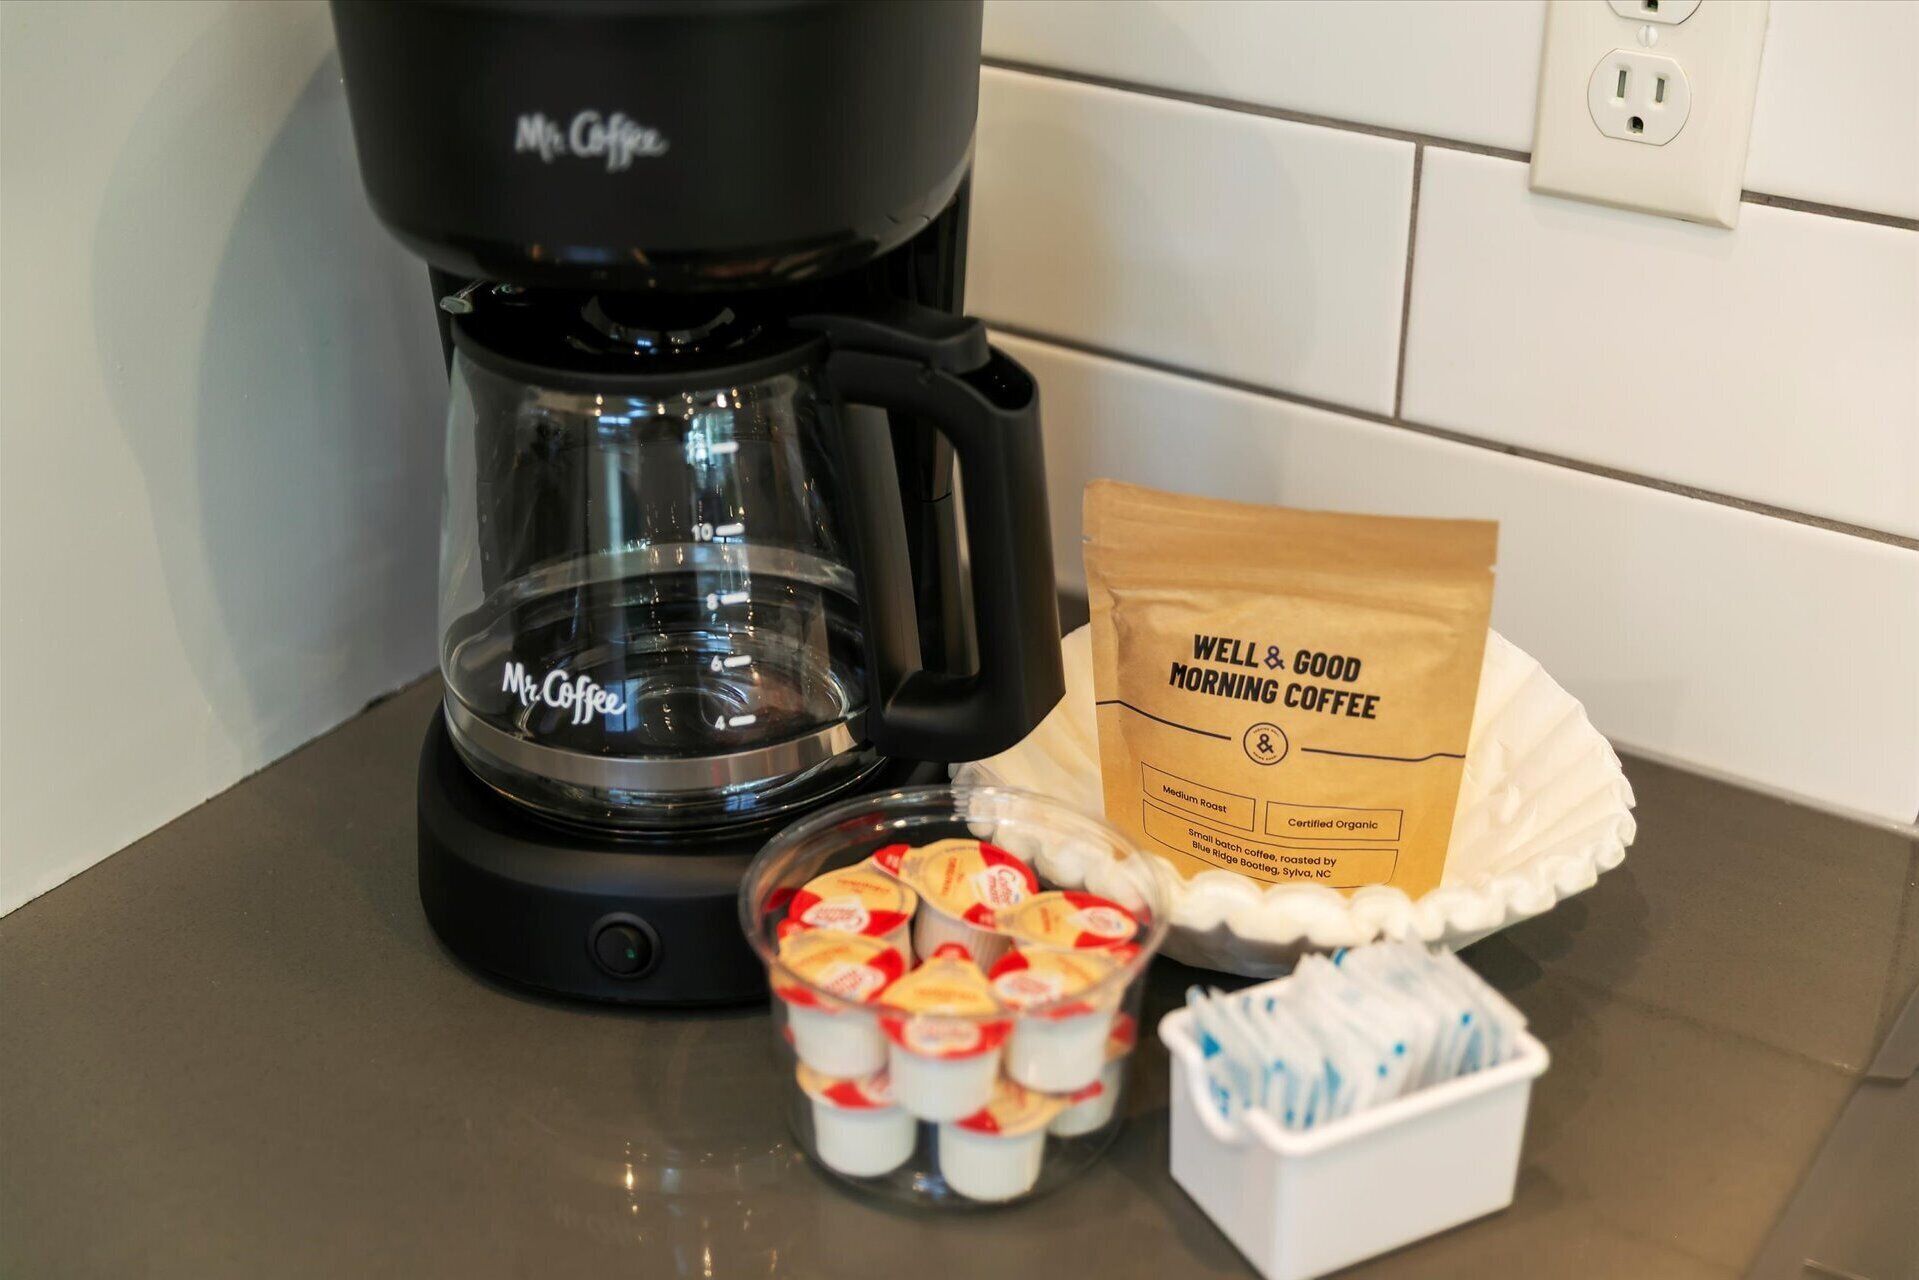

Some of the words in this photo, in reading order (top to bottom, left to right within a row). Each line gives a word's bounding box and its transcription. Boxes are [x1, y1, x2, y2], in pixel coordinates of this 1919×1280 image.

[569, 110, 670, 173] Coffee
[691, 523, 713, 541] 10
[707, 593, 719, 610] 8
[711, 656, 723, 672] 6
[1193, 634, 1259, 668] WELL
[1263, 645, 1285, 670] &
[1293, 649, 1361, 683] GOOD
[542, 669, 627, 725] Coffee
[1169, 662, 1279, 704] MORNING
[1284, 682, 1381, 719] COFFEE
[715, 714, 726, 731] 4
[1256, 733, 1274, 754] &
[1163, 785, 1198, 803] Medium
[1201, 798, 1227, 813] Roast
[1287, 817, 1333, 829] Certified
[1335, 819, 1378, 830] Organic
[1188, 827, 1214, 844] Small
[1215, 836, 1242, 853] batch
[1244, 846, 1278, 862] coffee,
[1280, 854, 1320, 866] roasted
[1323, 856, 1337, 867] by
[1192, 840, 1211, 854] Blue
[1212, 848, 1238, 864] Ridge
[1240, 859, 1281, 876] Bootleg,
[1282, 867, 1313, 878] Sylva,
[1315, 869, 1331, 879] NC
